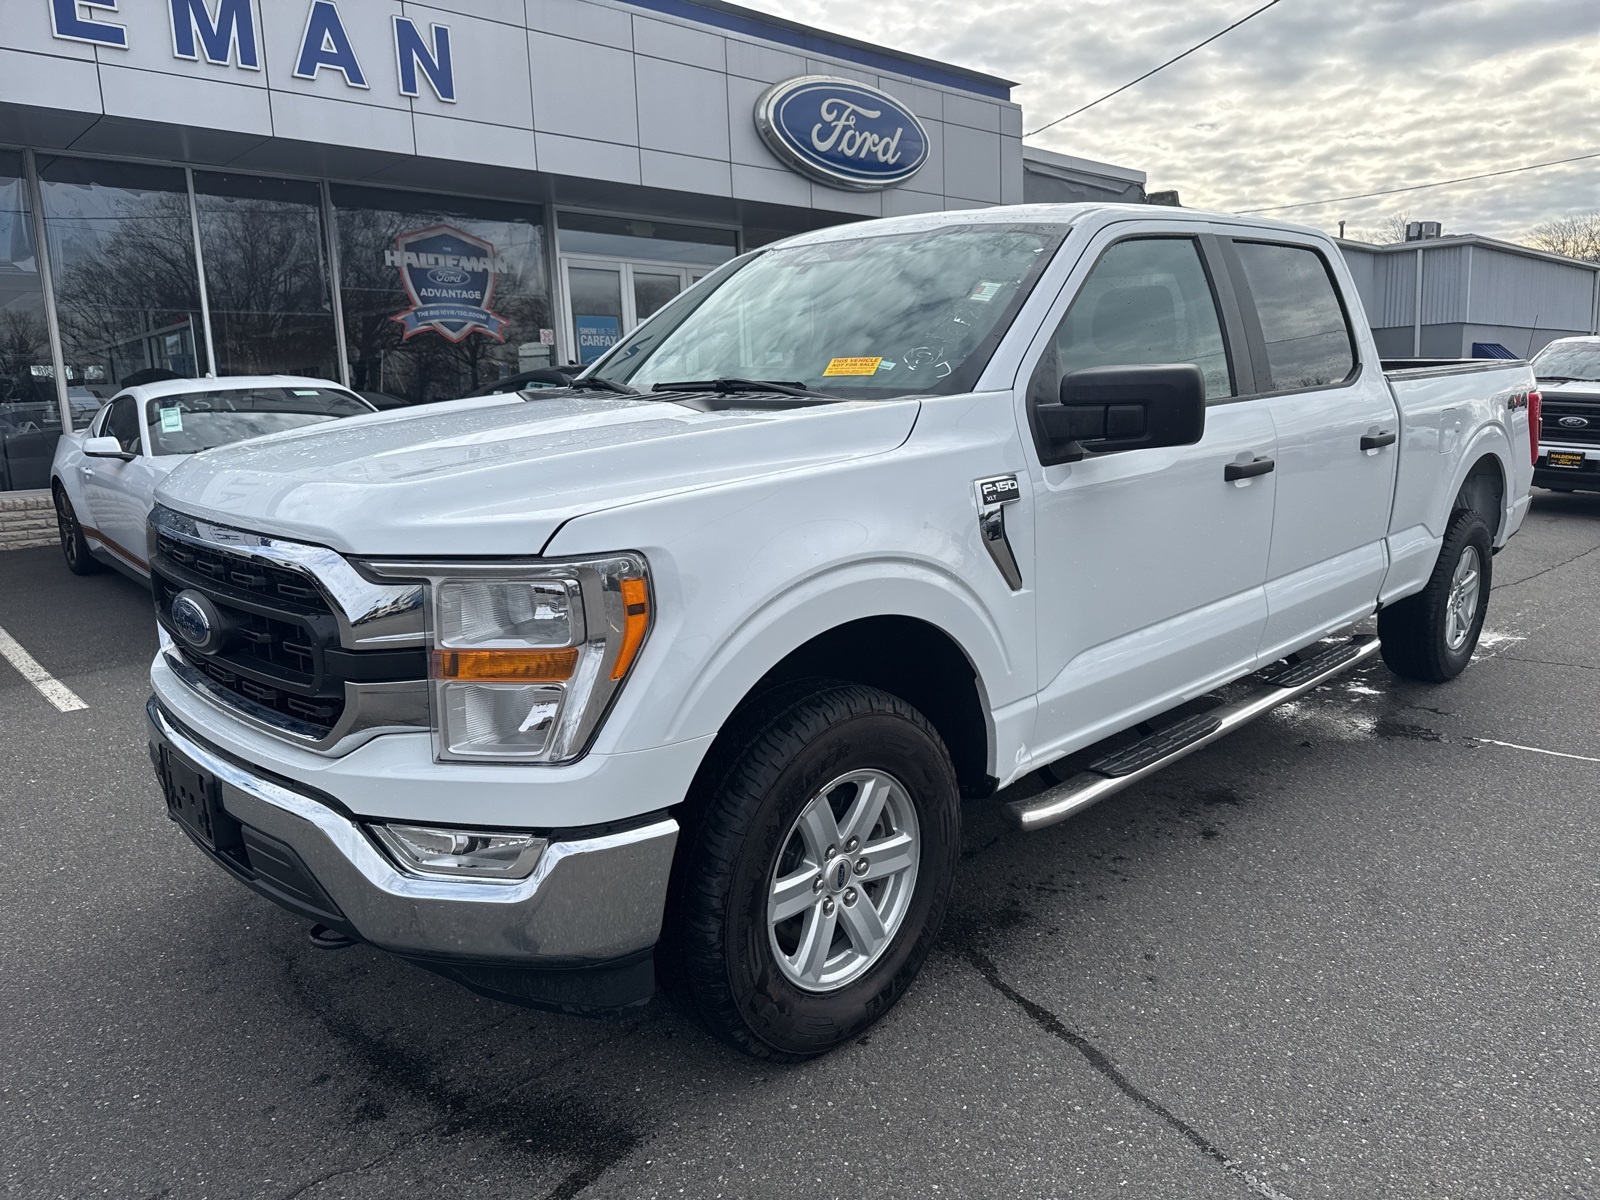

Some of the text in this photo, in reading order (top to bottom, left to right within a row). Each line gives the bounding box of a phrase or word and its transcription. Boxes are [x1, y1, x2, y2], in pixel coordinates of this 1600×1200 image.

[811, 98, 903, 165] Ford
[384, 249, 508, 274] HALDEMAN
[436, 270, 463, 283] Ford
[420, 288, 482, 300] ADVANTAGE
[579, 327, 597, 335] SHOW
[607, 328, 617, 336] THE
[580, 335, 617, 347] CARFAX
[981, 480, 1018, 495] F-150
